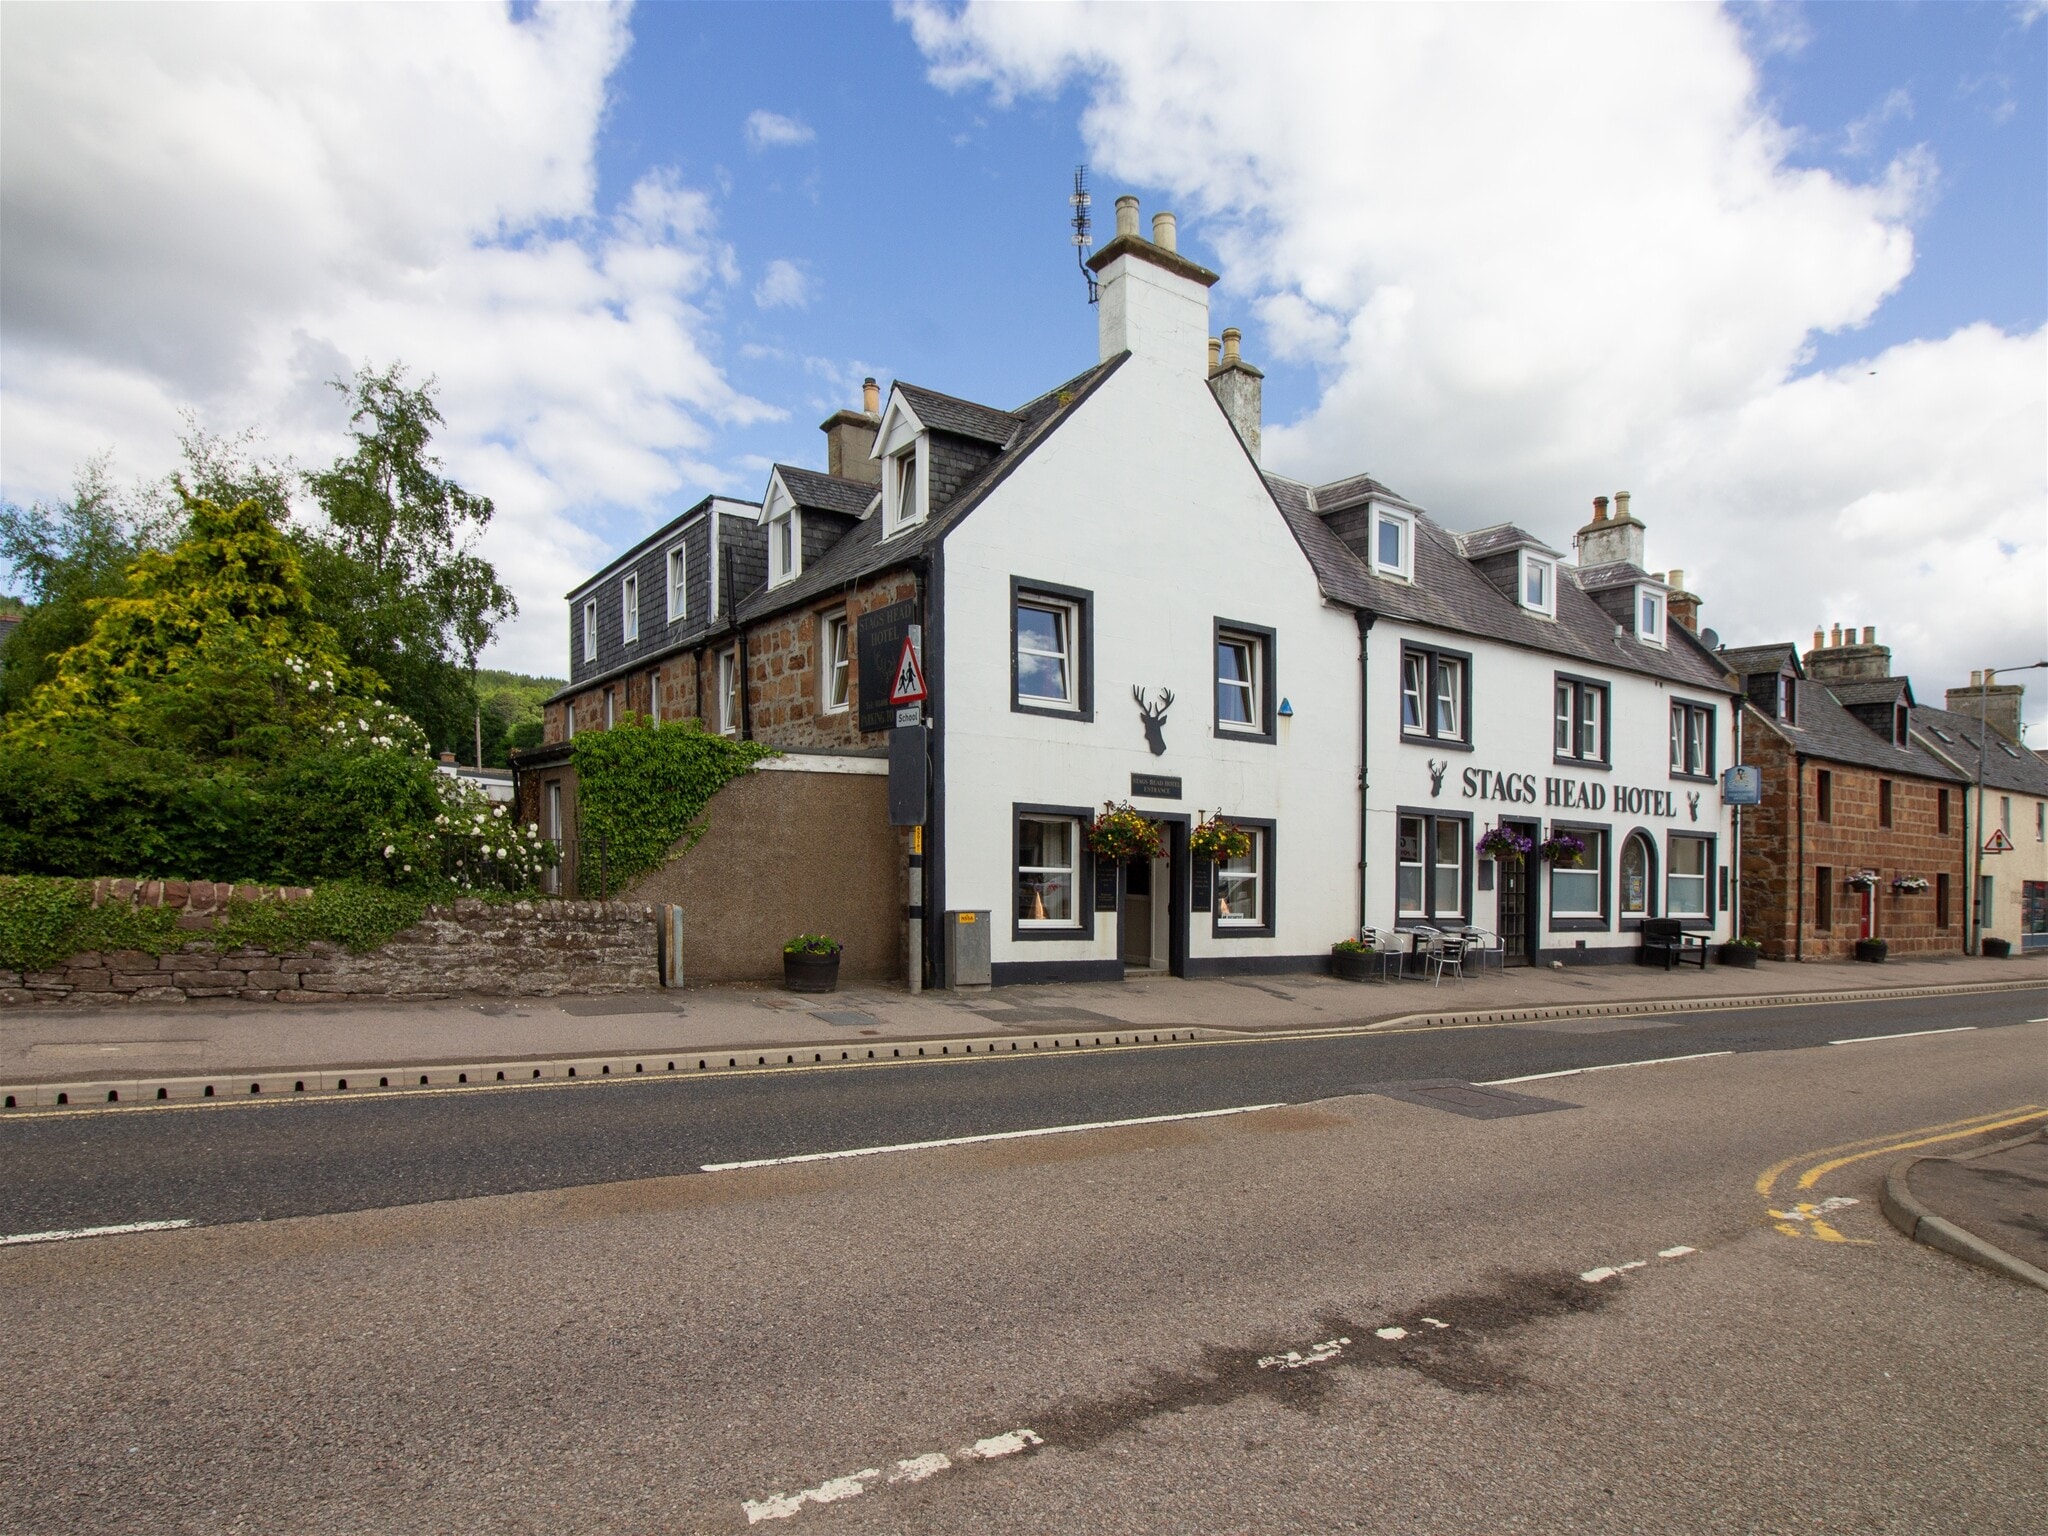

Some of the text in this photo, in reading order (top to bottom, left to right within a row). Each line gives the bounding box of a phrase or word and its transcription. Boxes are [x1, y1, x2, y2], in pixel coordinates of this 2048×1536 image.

[860, 604, 911, 633] STAGS HEAD
[871, 626, 899, 646] HOTEL
[898, 712, 918, 723] School
[1143, 786, 1171, 794] ENTRANCE
[1165, 780, 1181, 788] HOTEL
[1462, 767, 1677, 817] STAGS HEAD HOTEL
